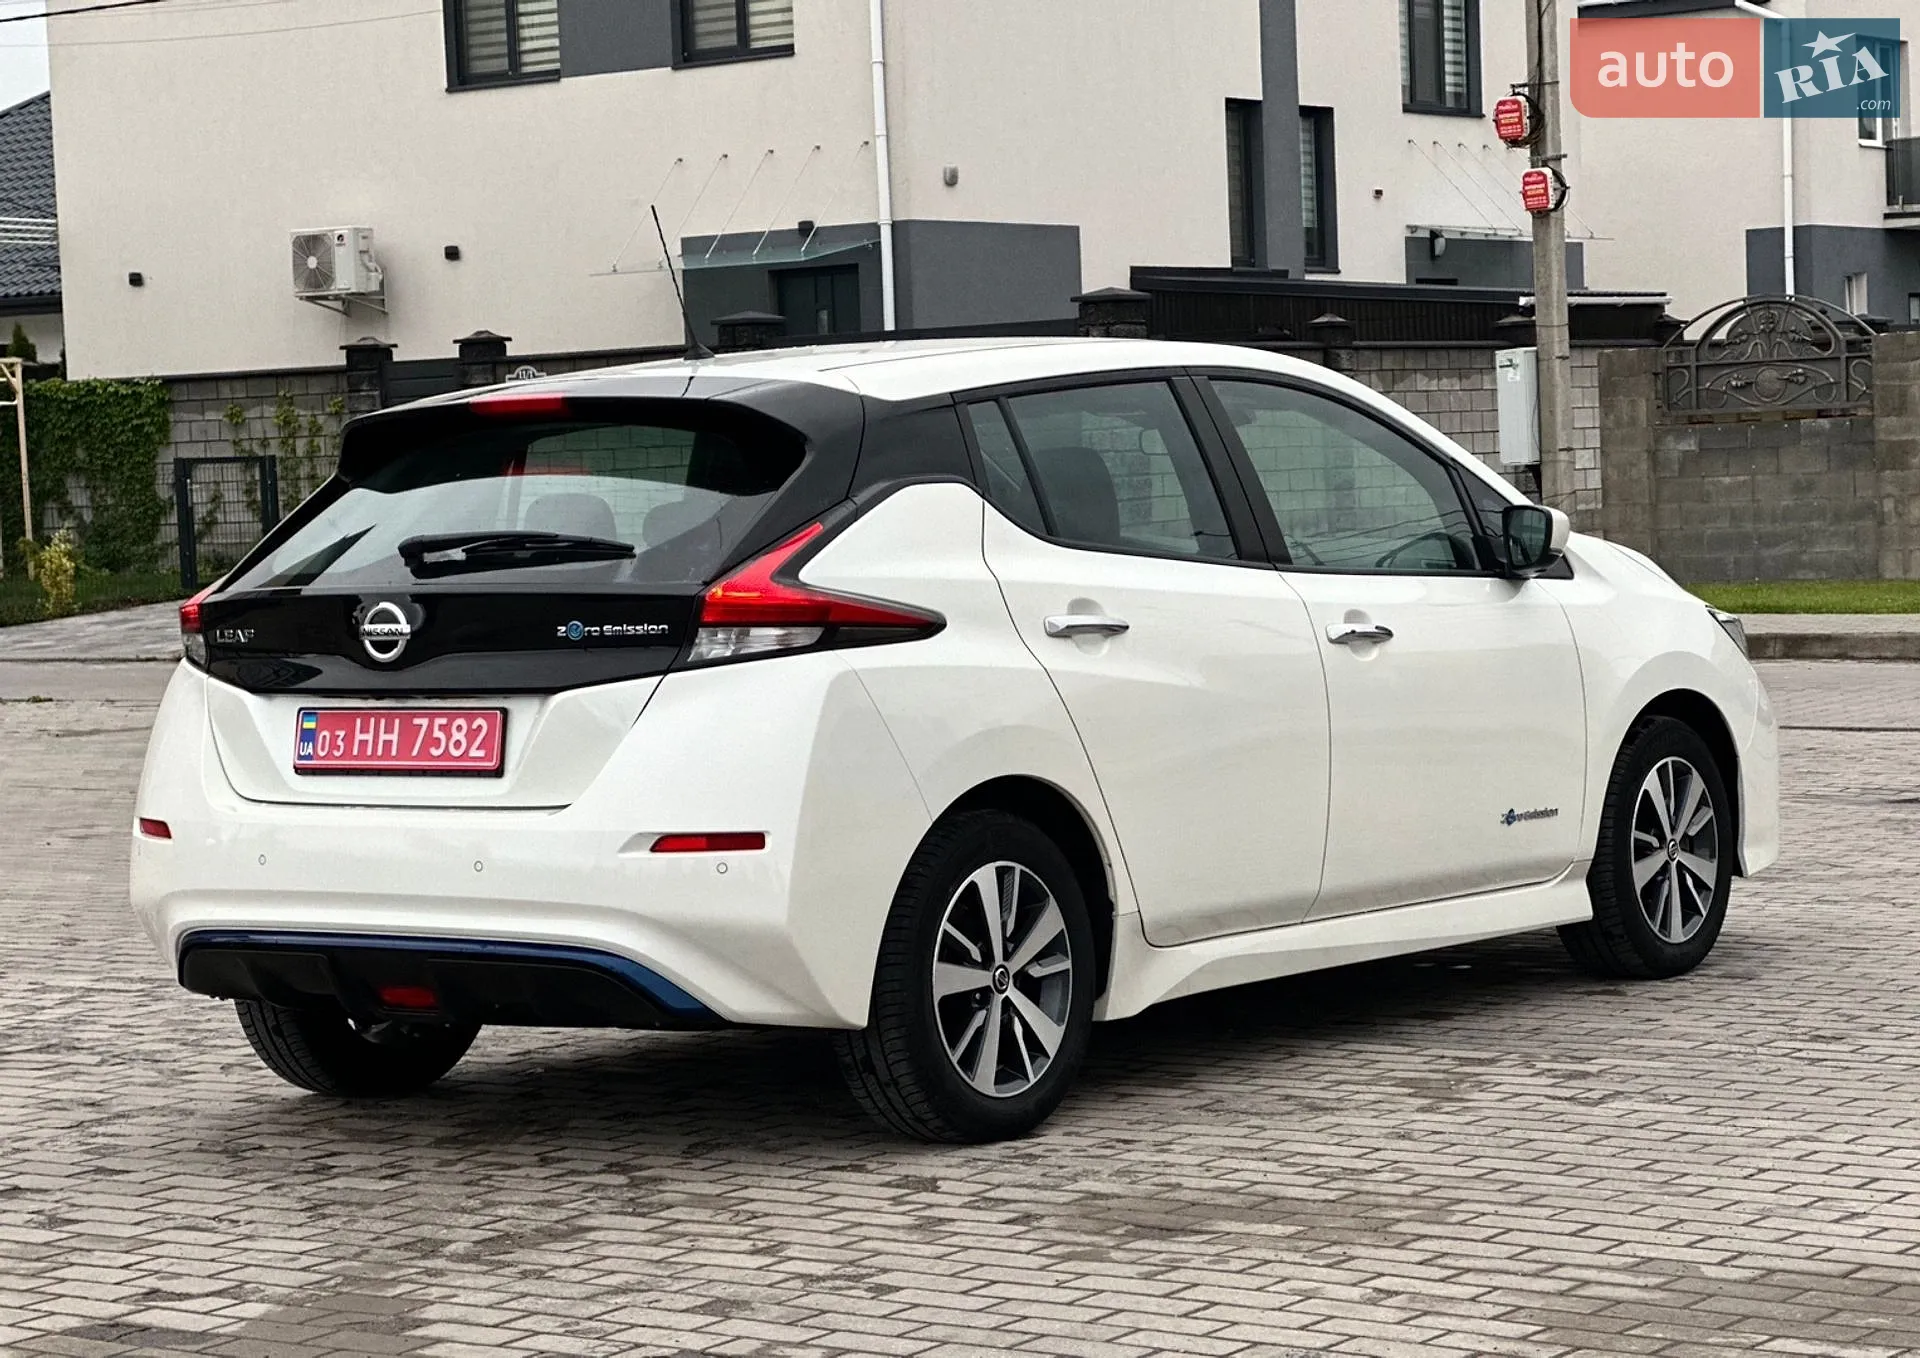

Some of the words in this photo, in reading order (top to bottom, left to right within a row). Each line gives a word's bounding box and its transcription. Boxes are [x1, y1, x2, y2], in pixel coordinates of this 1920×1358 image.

[216, 629, 255, 643] LEAF
[316, 730, 346, 757] 03
[352, 717, 400, 757] HH
[411, 717, 489, 758] 7582
[299, 741, 314, 756] UA
